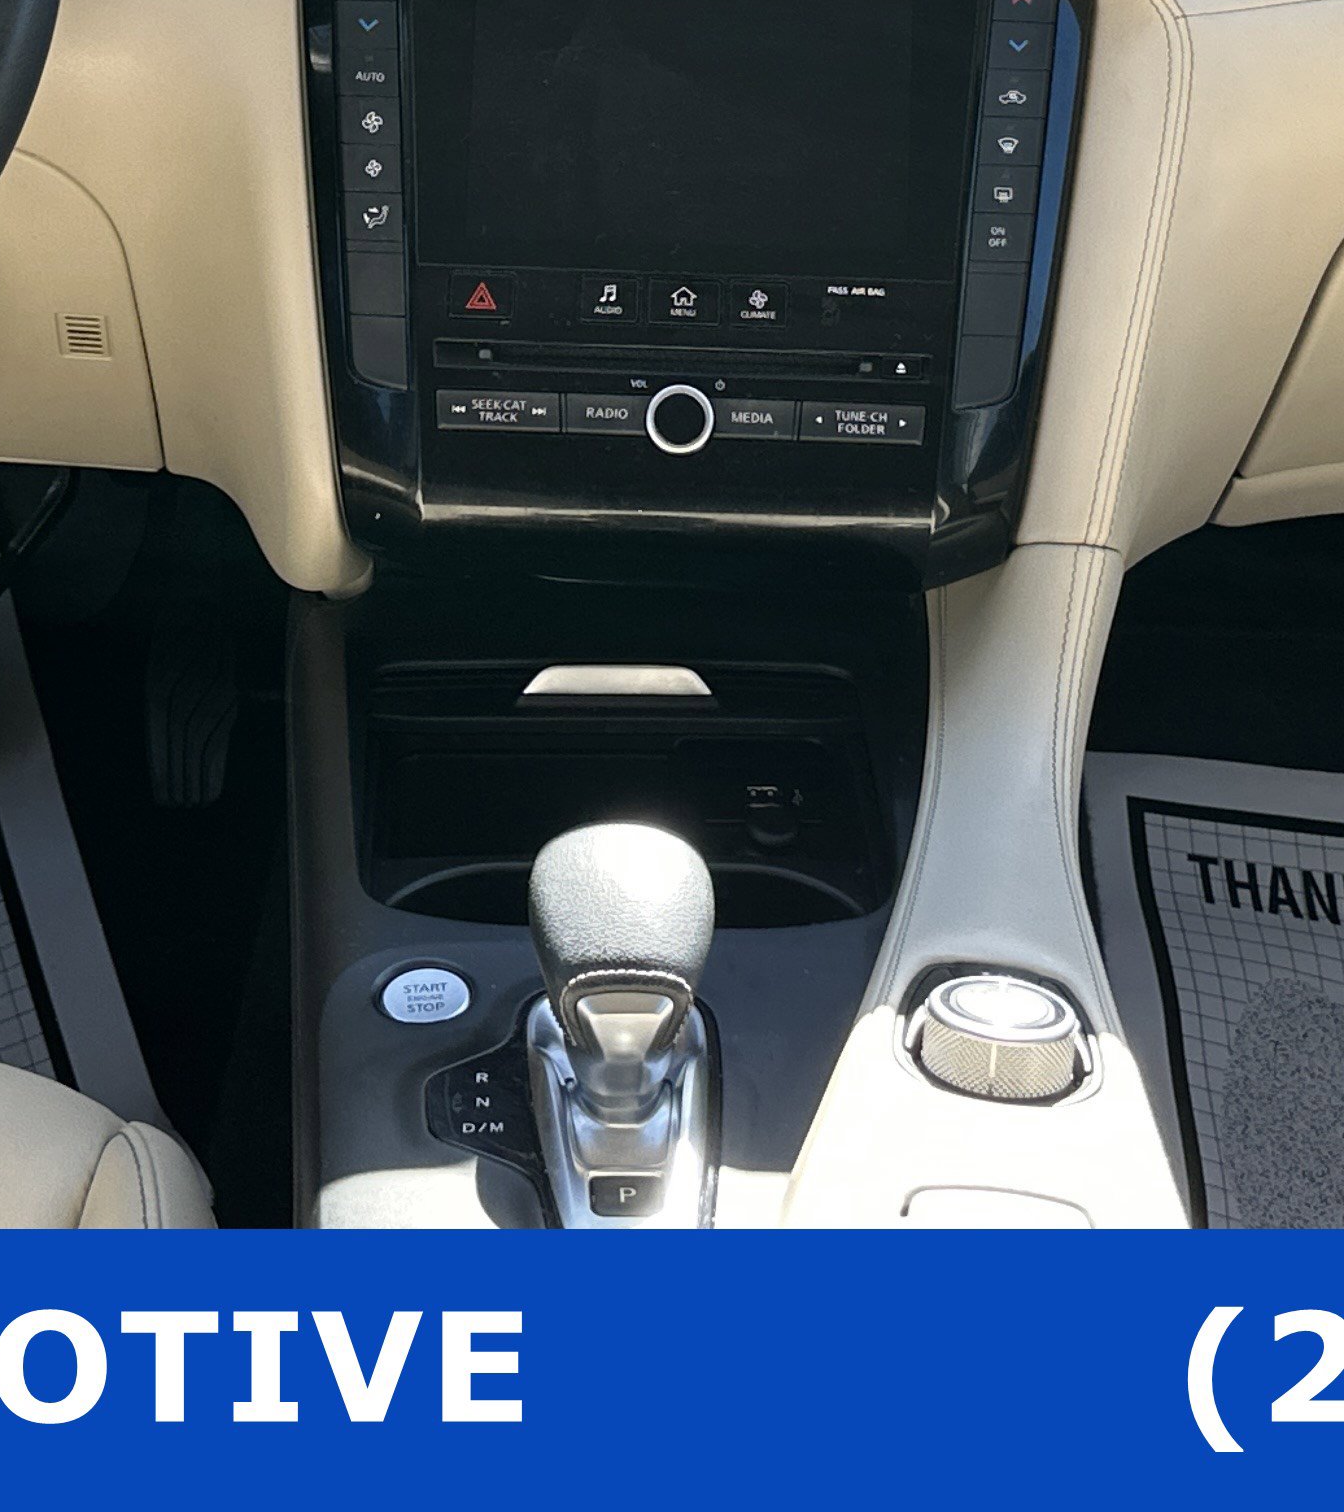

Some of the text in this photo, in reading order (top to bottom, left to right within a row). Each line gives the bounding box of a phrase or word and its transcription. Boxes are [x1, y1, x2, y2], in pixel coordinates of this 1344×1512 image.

[355, 70, 386, 84] AUTO
[990, 225, 1006, 236] ON
[988, 238, 1008, 248] OFF
[593, 305, 623, 316] AUDIO
[670, 308, 697, 318] MENU
[740, 309, 777, 320] CLIMATE
[629, 378, 649, 389] VOL
[478, 410, 520, 423] TRACK
[585, 405, 629, 420] RADIO
[730, 411, 774, 425] MEDIA
[837, 422, 886, 436] FOLDER
[402, 981, 448, 994] START
[406, 1001, 446, 1014] STOP
[475, 1072, 489, 1083] R
[475, 1096, 490, 1108] N
[462, 1120, 505, 1134] D/M
[618, 1186, 637, 1204] P
